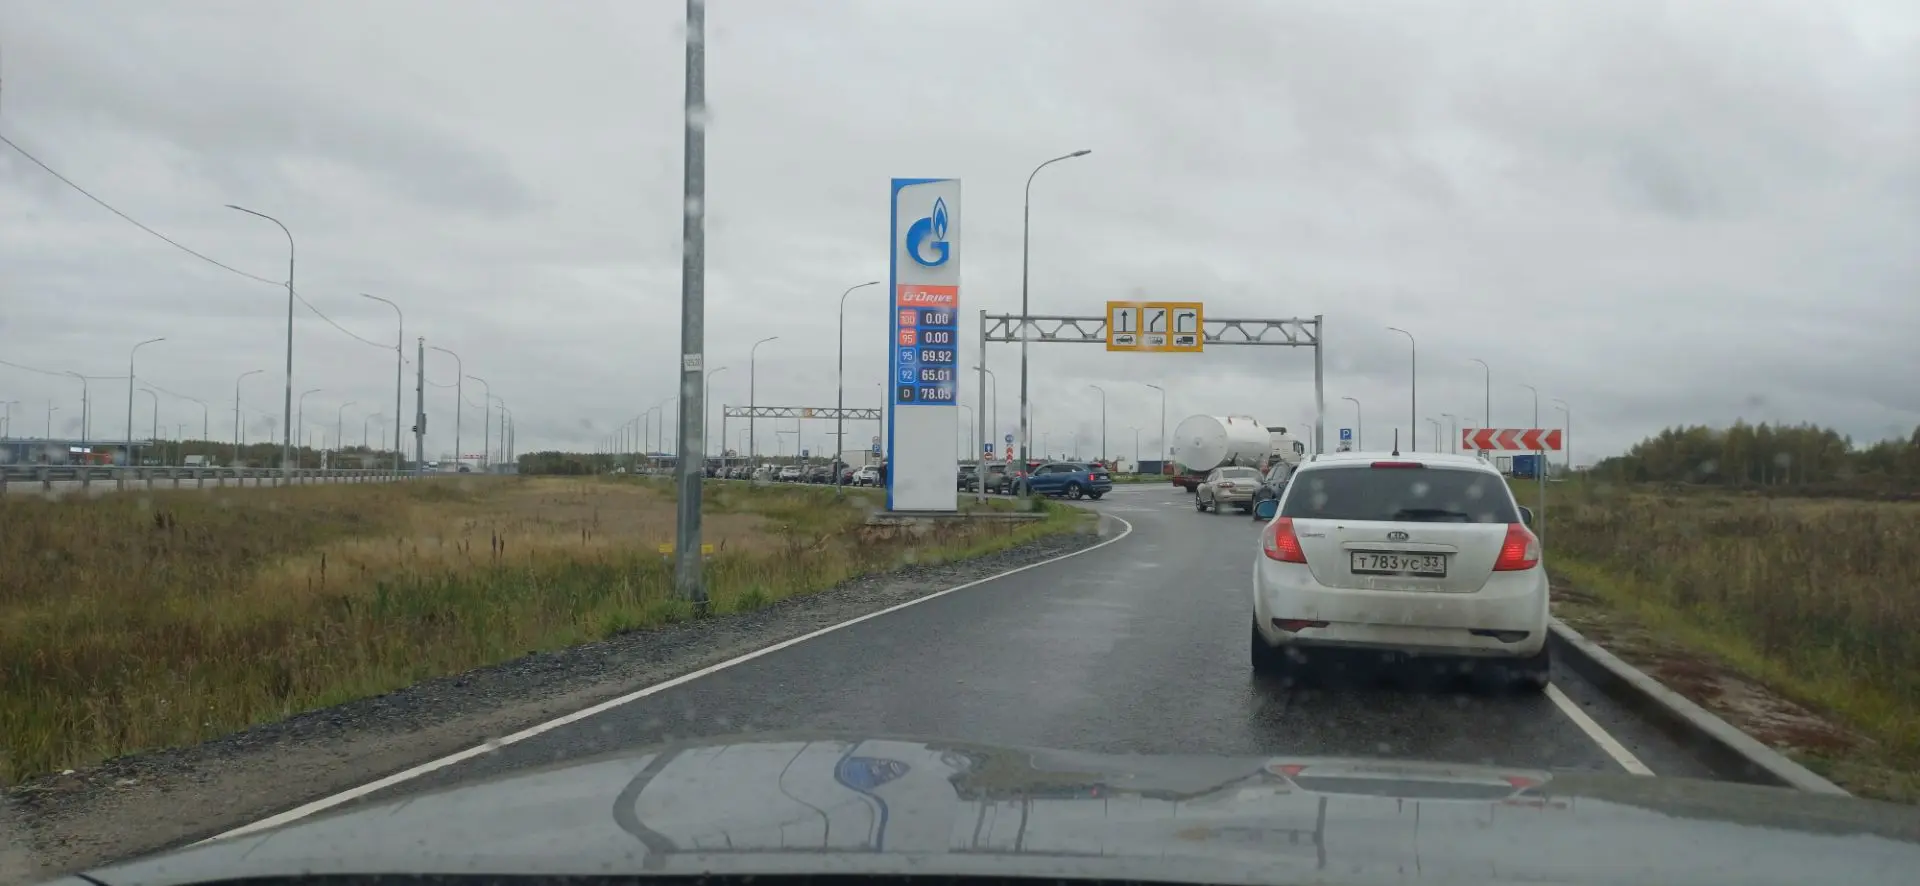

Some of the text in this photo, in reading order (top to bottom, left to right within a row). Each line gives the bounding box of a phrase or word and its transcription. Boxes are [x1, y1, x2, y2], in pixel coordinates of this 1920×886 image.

[925, 312, 949, 325] 0.00
[902, 331, 949, 344] 95 0.00
[902, 350, 952, 362] 95 69.92
[902, 369, 952, 381] 92 65.01
[903, 388, 952, 400] D 78.05
